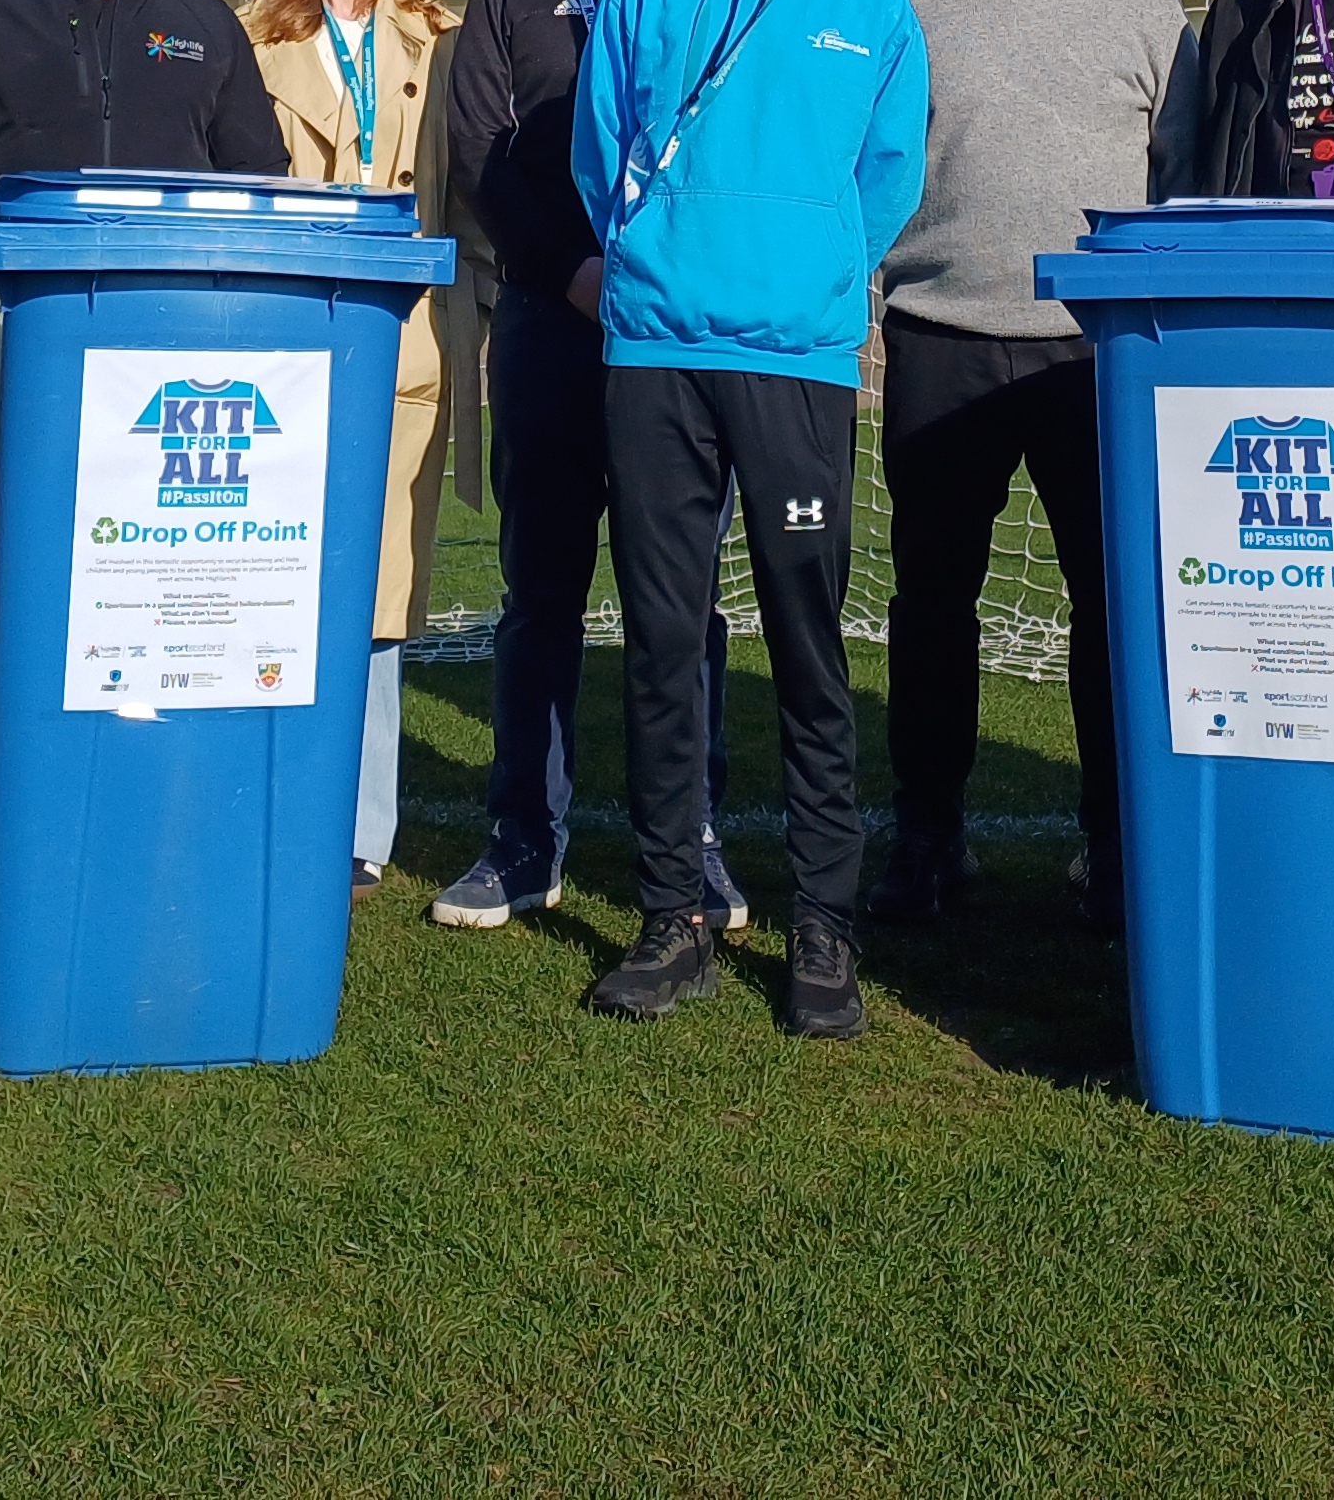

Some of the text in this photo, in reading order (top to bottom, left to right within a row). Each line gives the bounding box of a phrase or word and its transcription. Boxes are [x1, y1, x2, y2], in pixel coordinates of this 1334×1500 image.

[554, 8, 581, 16] adida
[162, 400, 253, 435] KIT
[185, 435, 226, 451] FOR
[1234, 438, 1328, 474] KIT
[158, 452, 249, 485] ALL
[1261, 475, 1304, 491] FOR
[161, 488, 245, 506] #PassItOn
[1238, 491, 1332, 528] ALL
[120, 519, 308, 547] Drop Off Point
[1243, 530, 1330, 549] #PassItOn
[1207, 562, 1275, 592] Drop
[1281, 564, 1324, 588] Off
[161, 673, 189, 689] DYW
[1266, 722, 1294, 739] DYW
